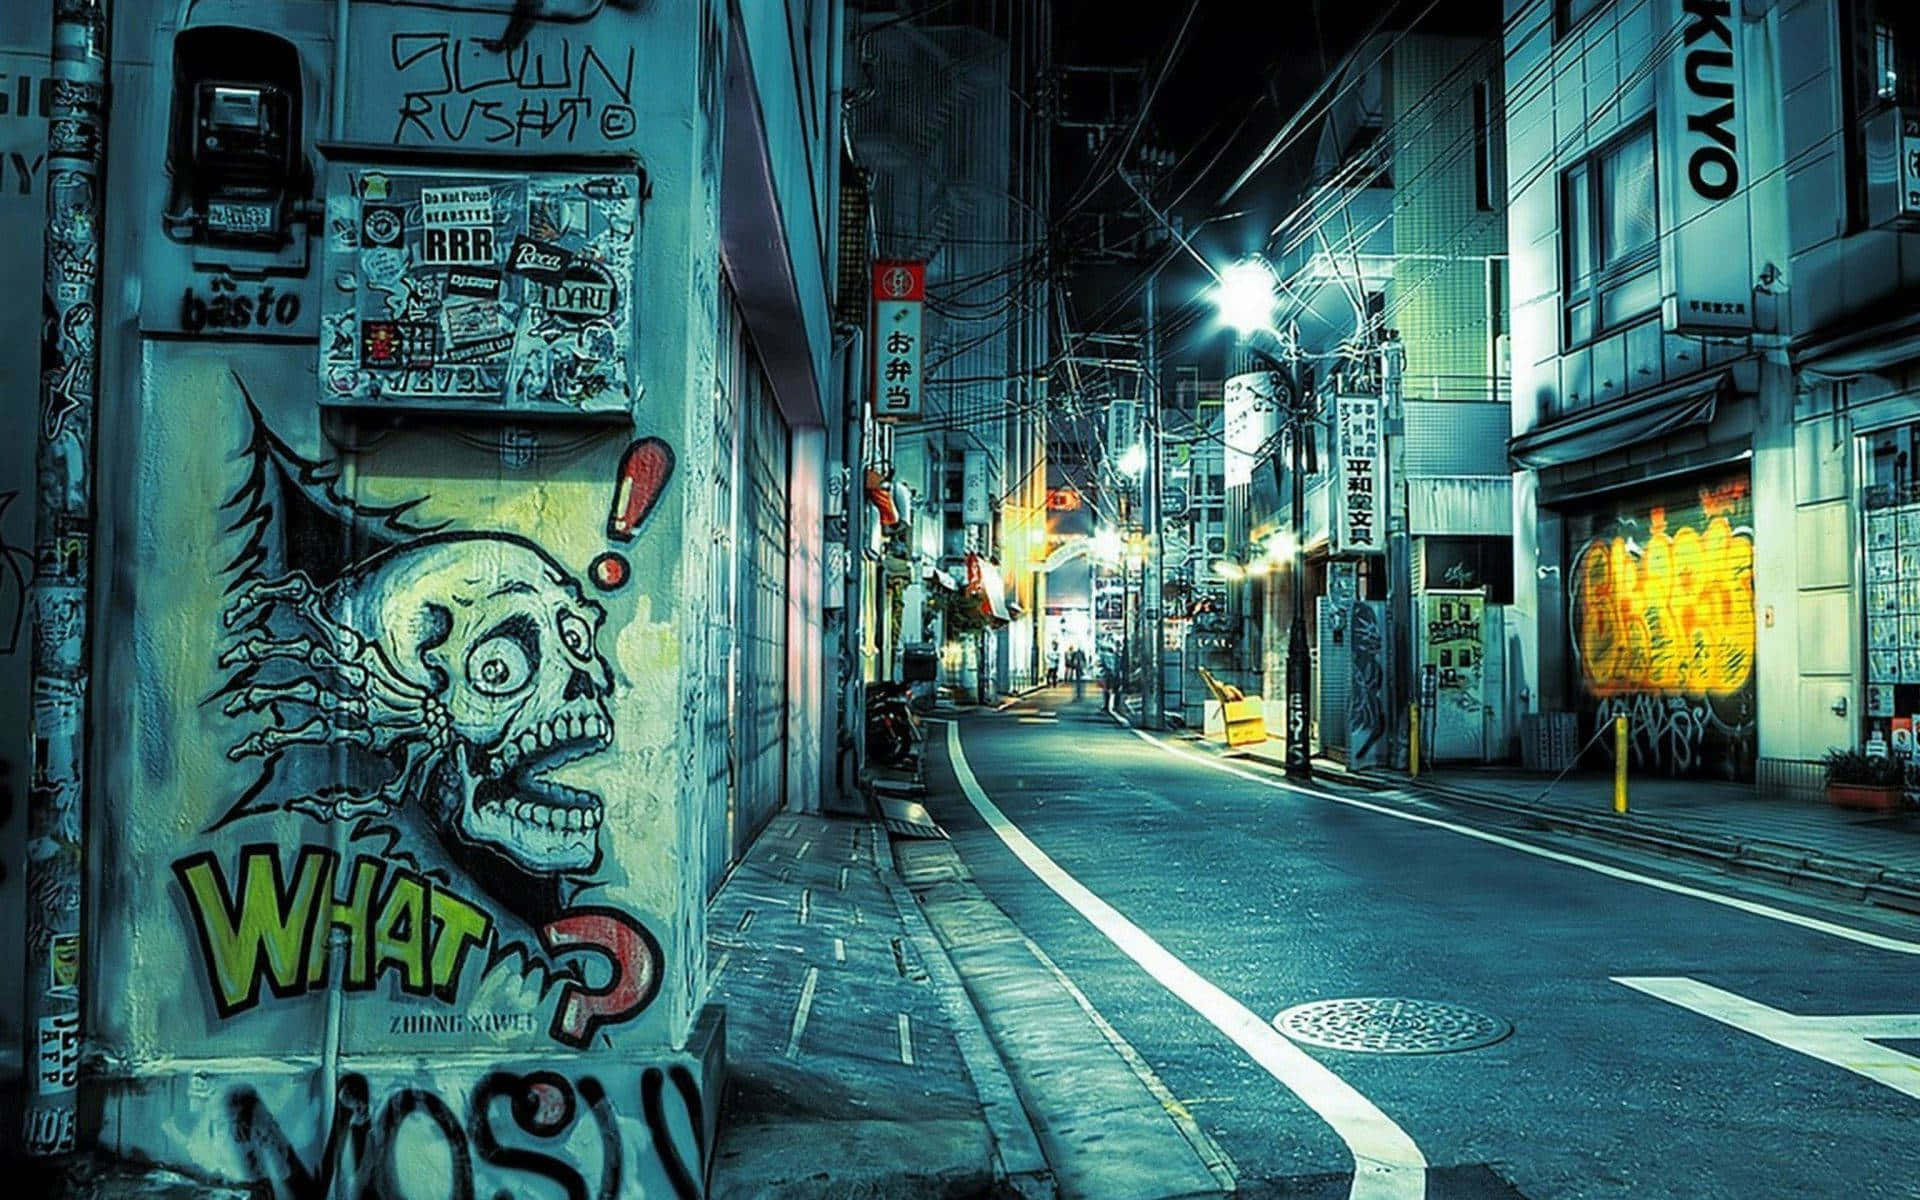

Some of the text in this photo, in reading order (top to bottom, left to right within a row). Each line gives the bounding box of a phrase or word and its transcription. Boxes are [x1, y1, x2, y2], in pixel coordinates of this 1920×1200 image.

[0, 152, 44, 196] Y
[427, 228, 493, 261] RRR
[885, 331, 915, 410] お弁当
[171, 843, 494, 1019] WHAT
